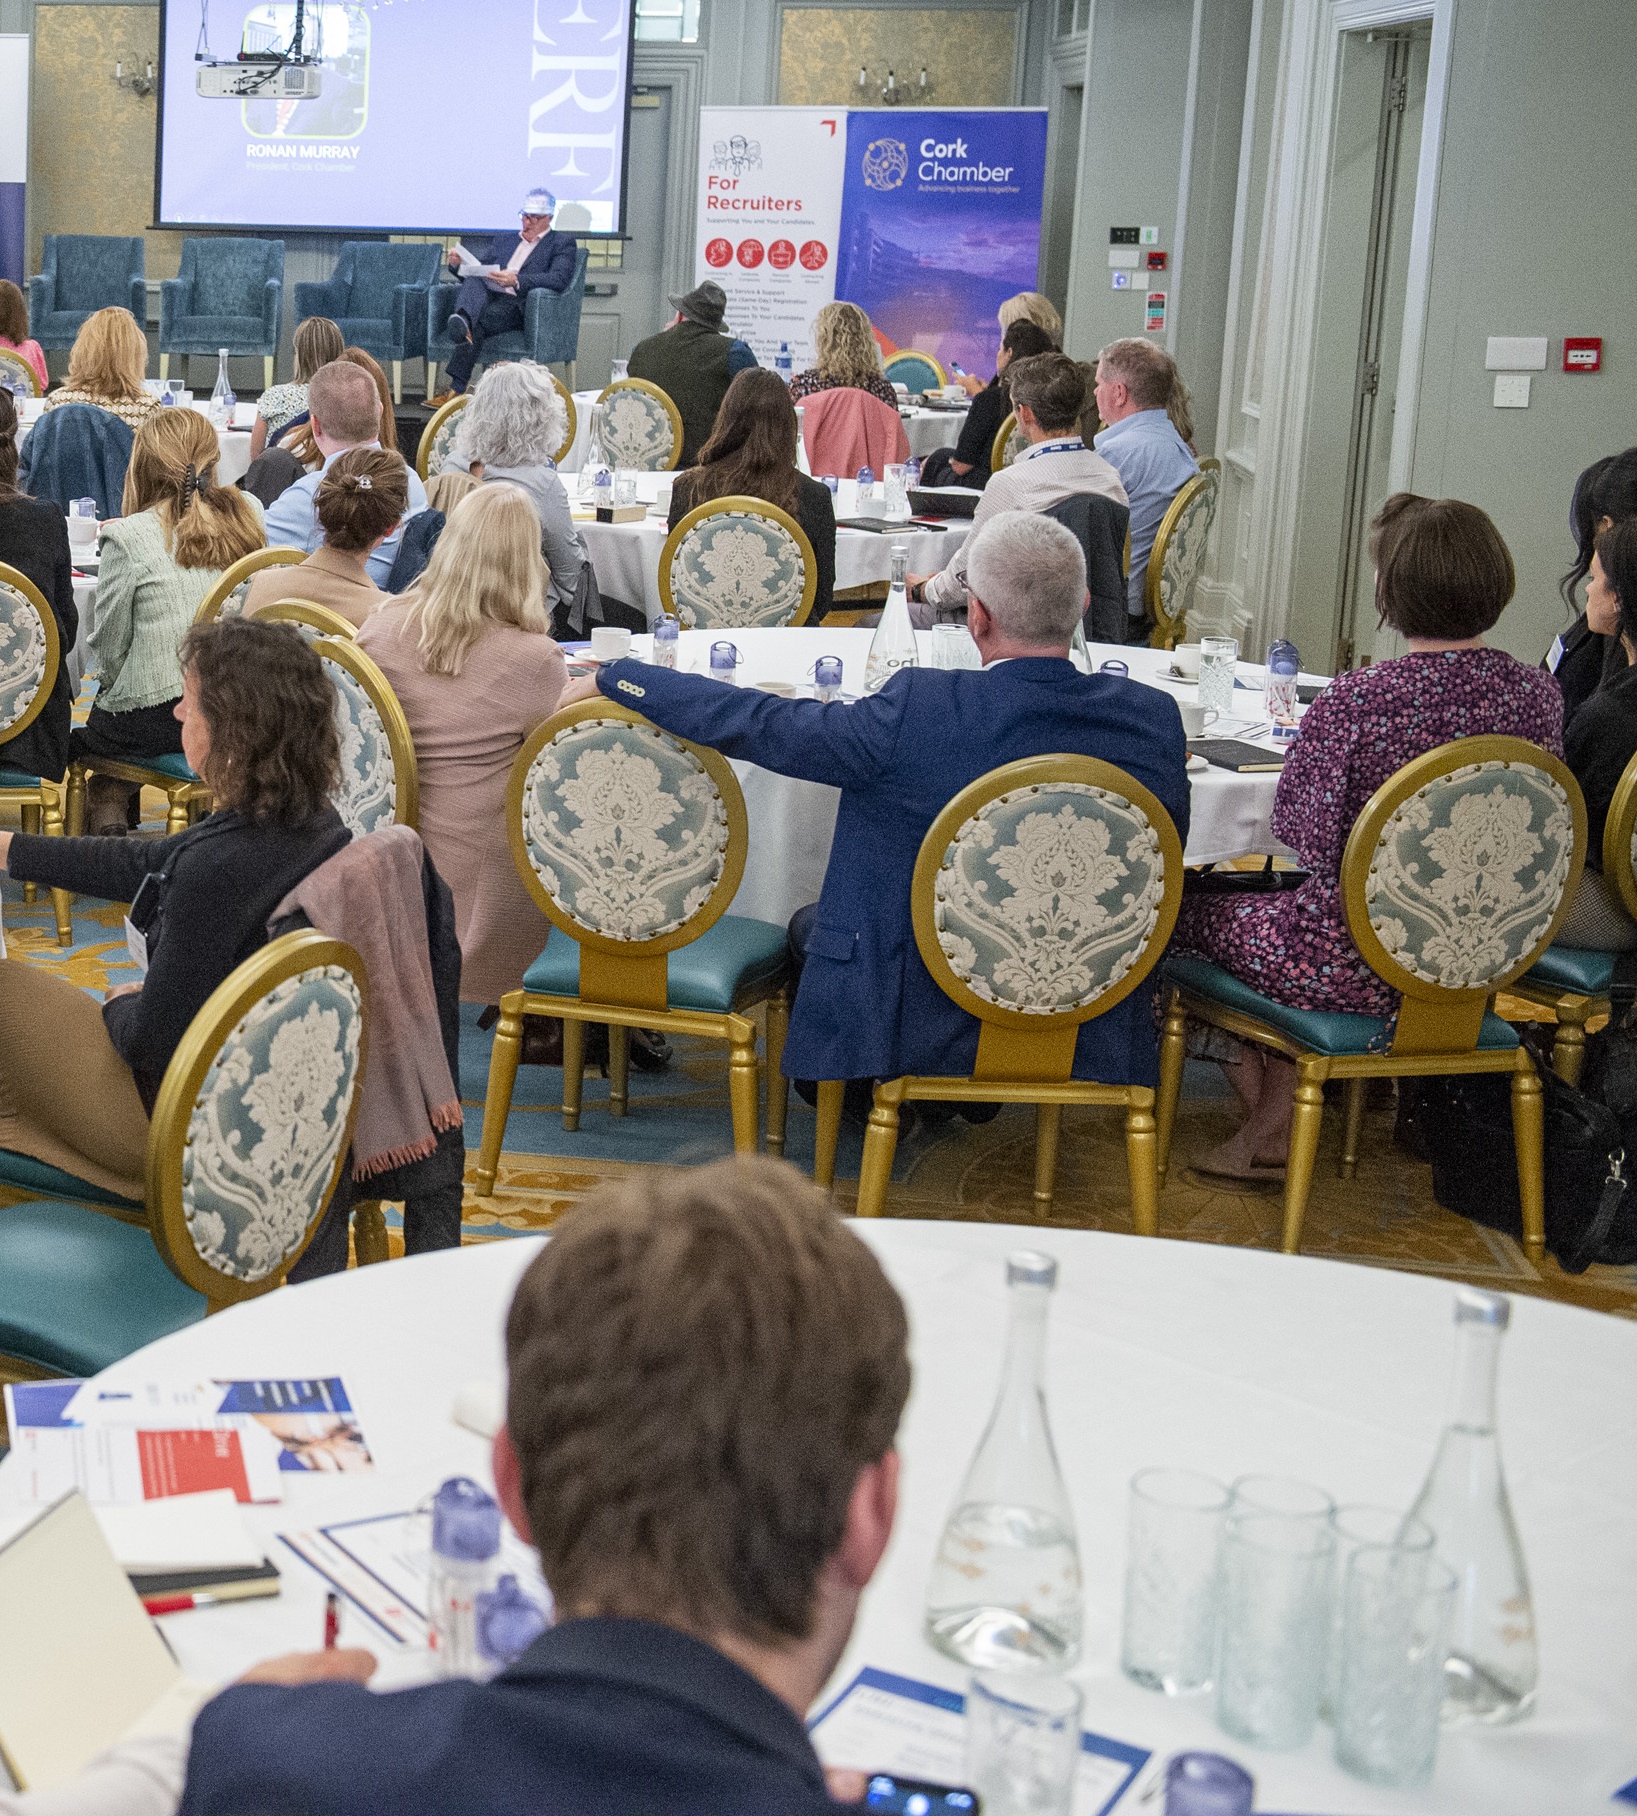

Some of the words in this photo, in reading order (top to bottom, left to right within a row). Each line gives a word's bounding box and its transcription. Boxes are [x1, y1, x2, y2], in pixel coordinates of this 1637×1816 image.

[527, 0, 624, 194] ERF
[246, 144, 297, 158] RONAN
[300, 145, 361, 159] MURRAY
[920, 137, 968, 158] Cork
[918, 161, 1014, 182] Chamber
[708, 175, 739, 190] For
[707, 195, 802, 211] Recruiters
